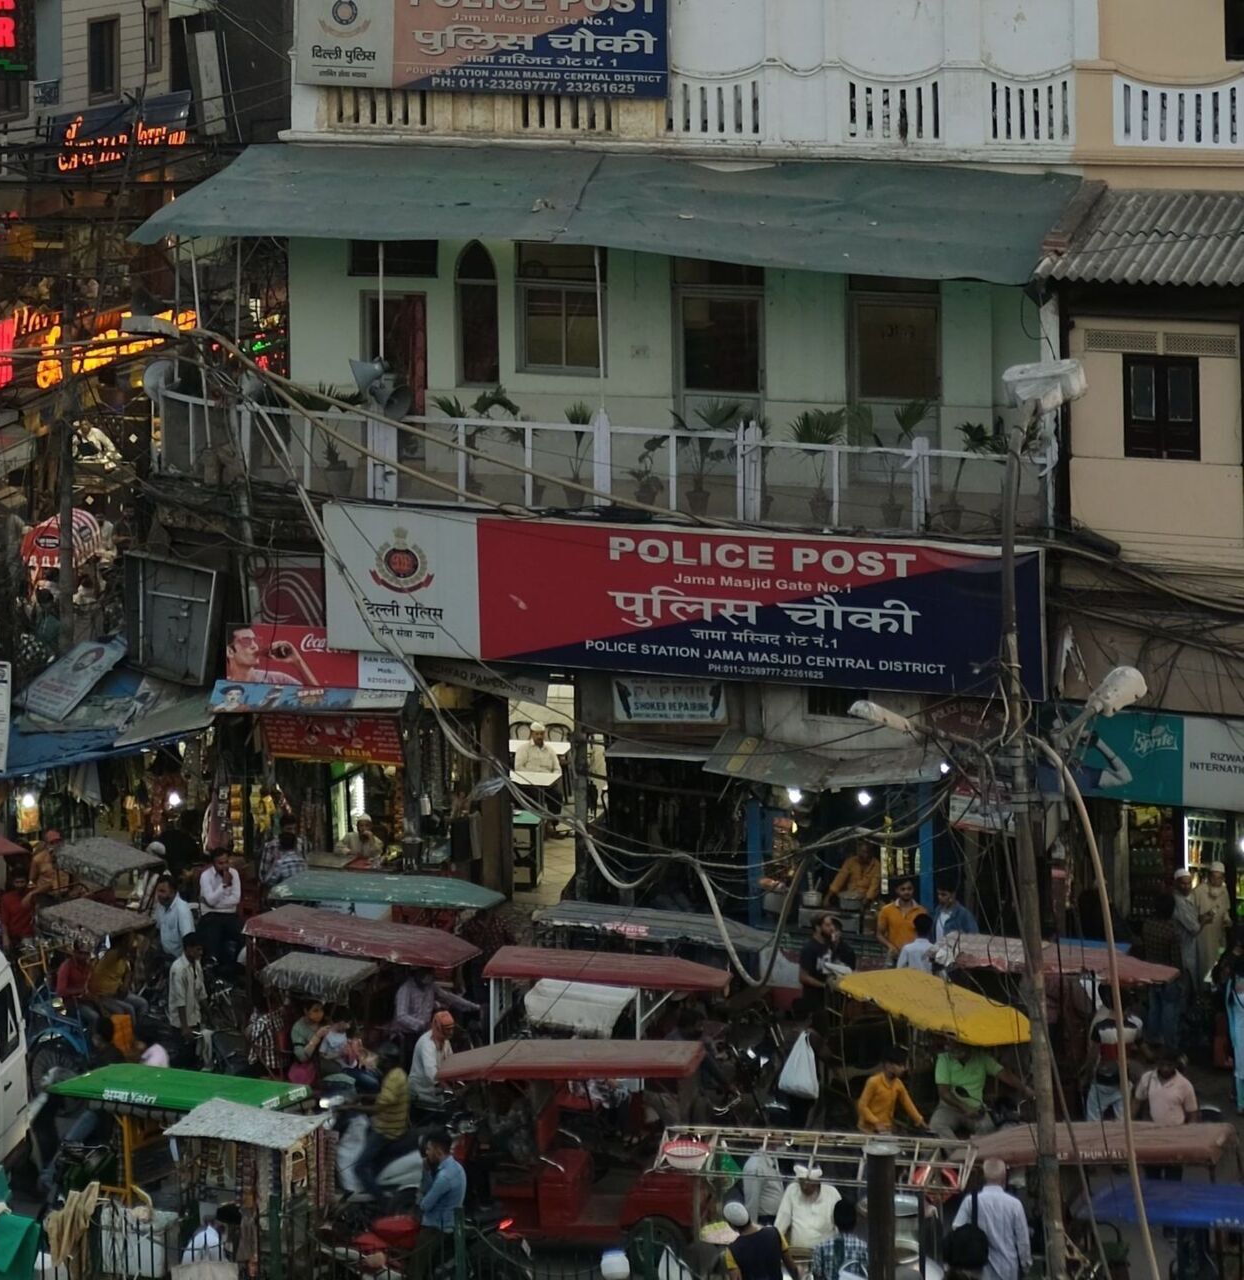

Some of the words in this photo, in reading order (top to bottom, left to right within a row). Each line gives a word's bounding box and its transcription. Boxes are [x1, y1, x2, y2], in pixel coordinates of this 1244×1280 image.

[451, 12, 490, 25] Jama
[494, 13, 540, 27] Masjid
[543, 14, 580, 26] Gate
[582, 15, 615, 27] No.1
[412, 26, 538, 54] पुलिस
[548, 27, 658, 55] चौकी
[311, 45, 342, 60] दिल्ली
[345, 46, 376, 64] पुलिस
[405, 66, 443, 77] POLICE
[445, 68, 488, 79] STATION
[491, 70, 520, 79] JAMA
[522, 71, 561, 81] MASJID
[563, 72, 613, 82] CENTRAL
[614, 73, 662, 83] DISTRICT
[432, 77, 456, 89] PH:
[566, 81, 636, 95] 23261625
[609, 536, 775, 571] POLICE
[792, 547, 917, 578] POST
[674, 573, 715, 586] Jama
[720, 575, 771, 590] Masjid
[776, 579, 813, 592] Gate
[817, 582, 852, 594] No.1
[405, 601, 444, 624] पुलिस
[607, 585, 764, 628] पुलिस
[776, 594, 922, 636] चौकी
[690, 628, 727, 642] जामा
[731, 629, 781, 646] मस्जिद
[585, 640, 637, 654] POLICE
[641, 643, 700, 659] STATION
[704, 648, 744, 662] JAMA
[747, 651, 803, 666] MASJID
[806, 655, 876, 671] CENTRAL
[879, 660, 946, 676] DISTRICT
[1136, 732, 1175, 753] Sprite
[1210, 752, 1244, 762] RIZWA
